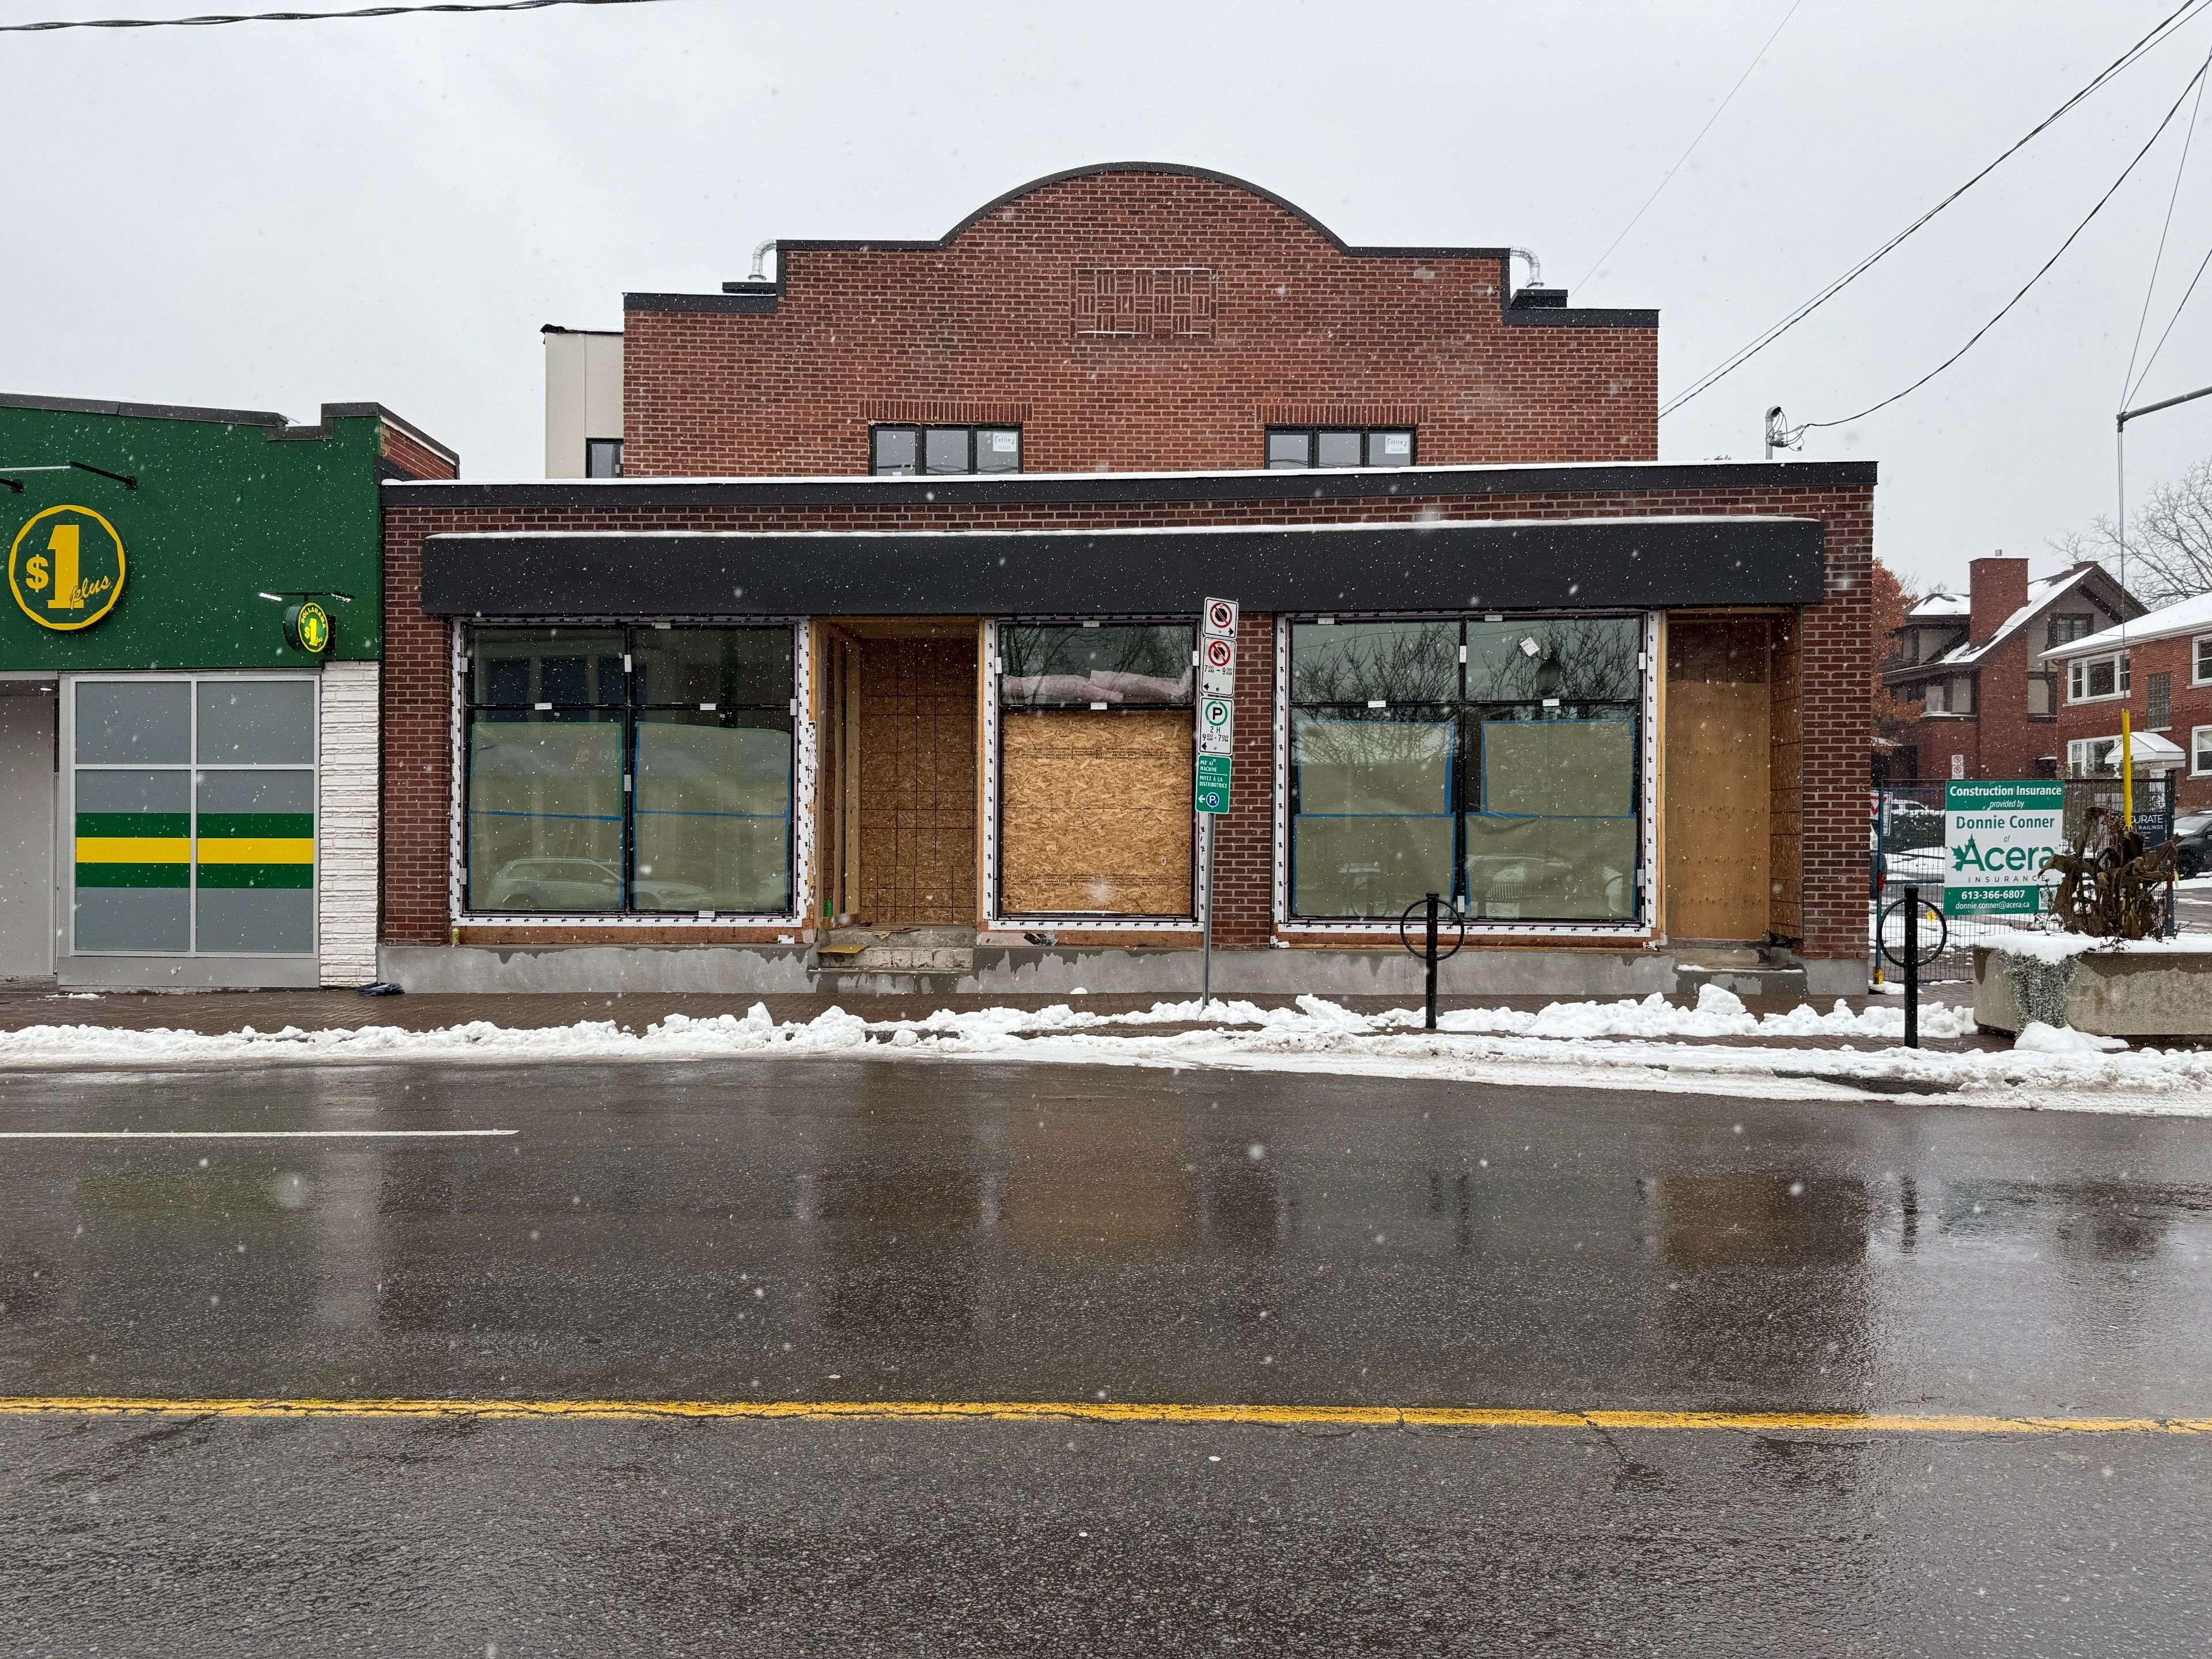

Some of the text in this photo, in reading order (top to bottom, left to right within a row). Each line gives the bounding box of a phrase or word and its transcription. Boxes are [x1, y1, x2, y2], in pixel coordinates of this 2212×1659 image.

[69, 575, 111, 610] plus
[301, 607, 326, 628] DOLLARAMA
[1212, 707, 1223, 720] P
[1949, 785, 2062, 797] Construction Insurance
[1989, 800, 2025, 809] provided by
[1956, 815, 2055, 830] Donnie Conner
[2003, 835, 2010, 843] of
[1960, 834, 2055, 872] Acera
[1968, 874, 2046, 883] INSURANCE
[1961, 890, 2025, 900] 613-366-6807
[1955, 901, 2030, 910] donnie.conner@acera.ca
